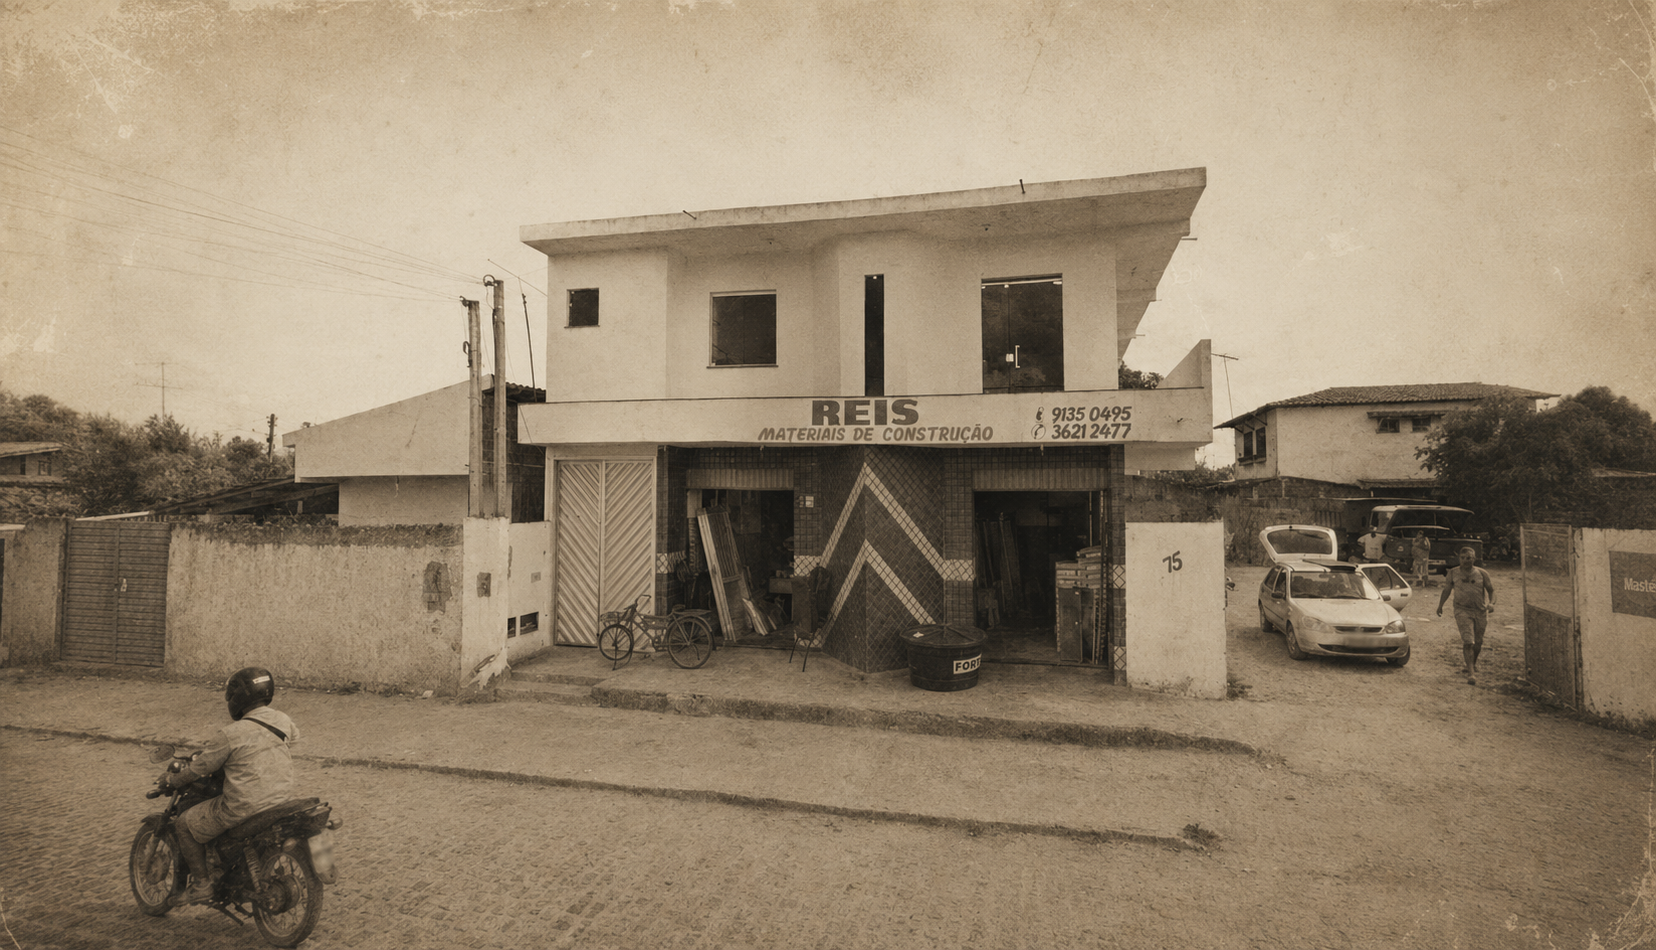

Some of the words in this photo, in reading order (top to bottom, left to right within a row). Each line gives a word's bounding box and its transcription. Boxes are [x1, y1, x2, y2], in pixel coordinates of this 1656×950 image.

[811, 399, 919, 426] REIS
[1052, 406, 1086, 424] 9135
[1089, 406, 1132, 422] 0495
[758, 427, 846, 443] MATERIAIS
[853, 427, 874, 442] DE
[883, 424, 994, 444] CONSTRUÇÃO
[1051, 423, 1087, 439] 3621
[1089, 423, 1131, 439] 2477
